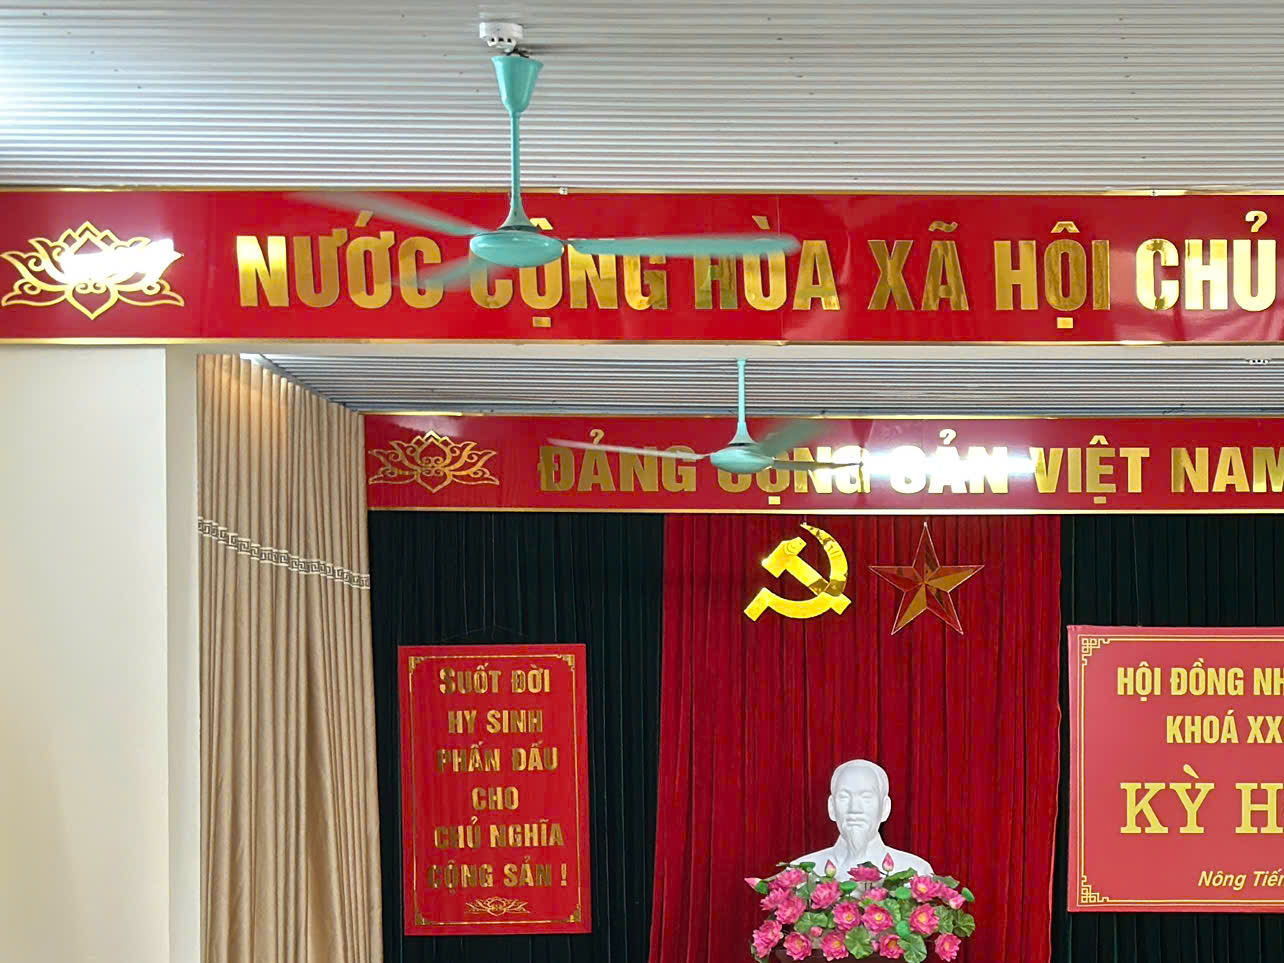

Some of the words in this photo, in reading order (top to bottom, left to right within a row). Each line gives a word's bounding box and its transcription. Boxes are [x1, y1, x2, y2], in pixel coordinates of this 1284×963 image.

[235, 210, 443, 311] NƯỚC
[469, 216, 669, 328] CỘNG
[694, 214, 841, 311] HÒA
[867, 220, 969, 312] XÃ
[993, 221, 1111, 330] HỘI
[1136, 210, 1277, 312] CHỦ
[537, 428, 697, 493] ĐẢNG
[717, 444, 872, 505] CỘNG
[888, 428, 1009, 494] SẢN
[1029, 434, 1150, 504] VIỆT
[439, 663, 501, 694] SUỐT
[511, 664, 551, 693] ĐỜI
[1116, 661, 1162, 702] HỘI
[1169, 658, 1245, 697] ĐỒNG
[448, 709, 478, 734] HY
[486, 709, 544, 734] SINH
[1166, 709, 1240, 744] KHOÁ
[436, 741, 502, 774] PHẤN
[511, 740, 559, 772] ĐẤU
[471, 785, 521, 812] CHO
[1120, 764, 1215, 836] KỲ
[434, 815, 481, 849] CHỦ
[489, 818, 565, 847] NGHĨA
[428, 859, 494, 895] CỘNG
[503, 855, 553, 888] SẢN
[560, 862, 569, 887] !
[1197, 871, 1246, 890] Nông
